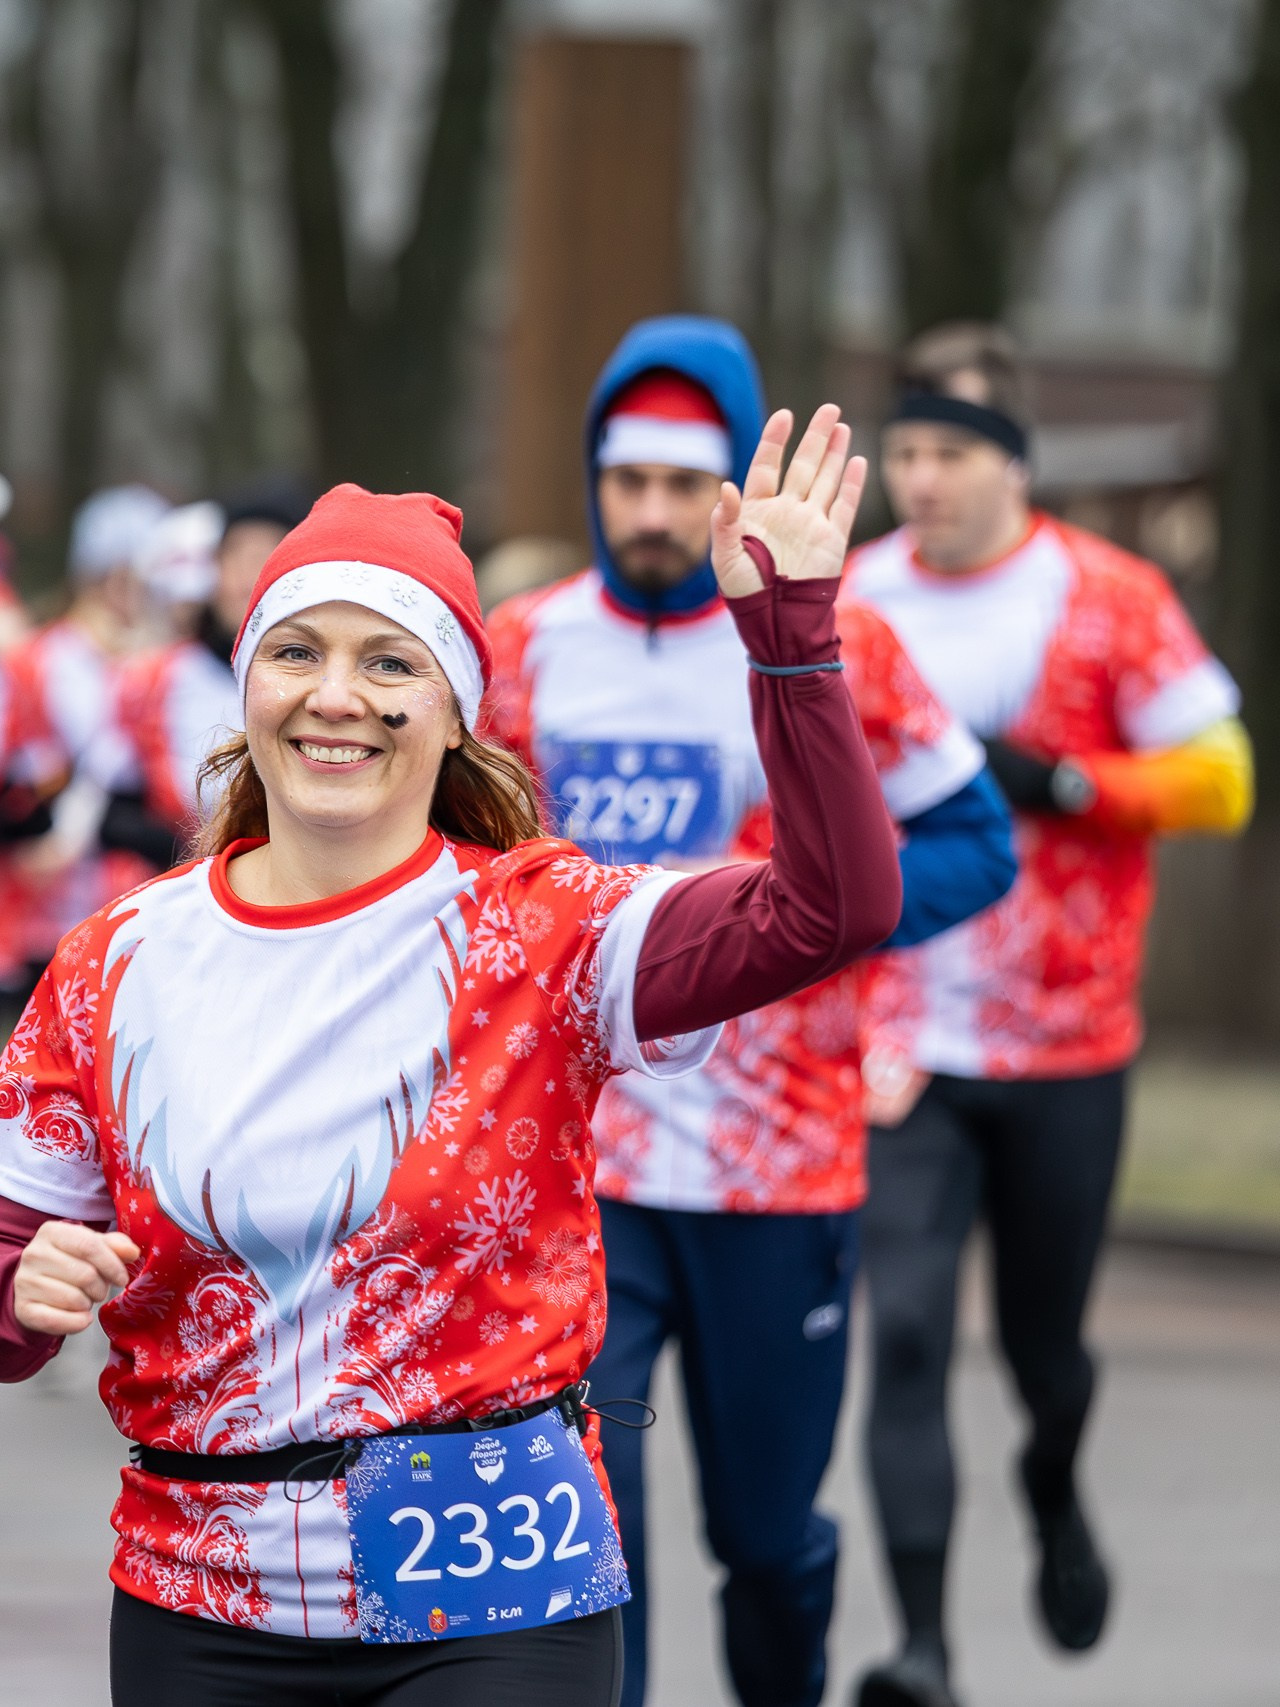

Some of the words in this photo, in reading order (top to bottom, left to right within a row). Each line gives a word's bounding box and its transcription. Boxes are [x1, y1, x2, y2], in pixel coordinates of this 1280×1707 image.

[561, 775, 702, 843] 2297
[411, 1472, 433, 1480] ПАРК
[388, 1481, 591, 1582] 2332
[486, 1607, 497, 1622] 5
[499, 1606, 522, 1620] км
